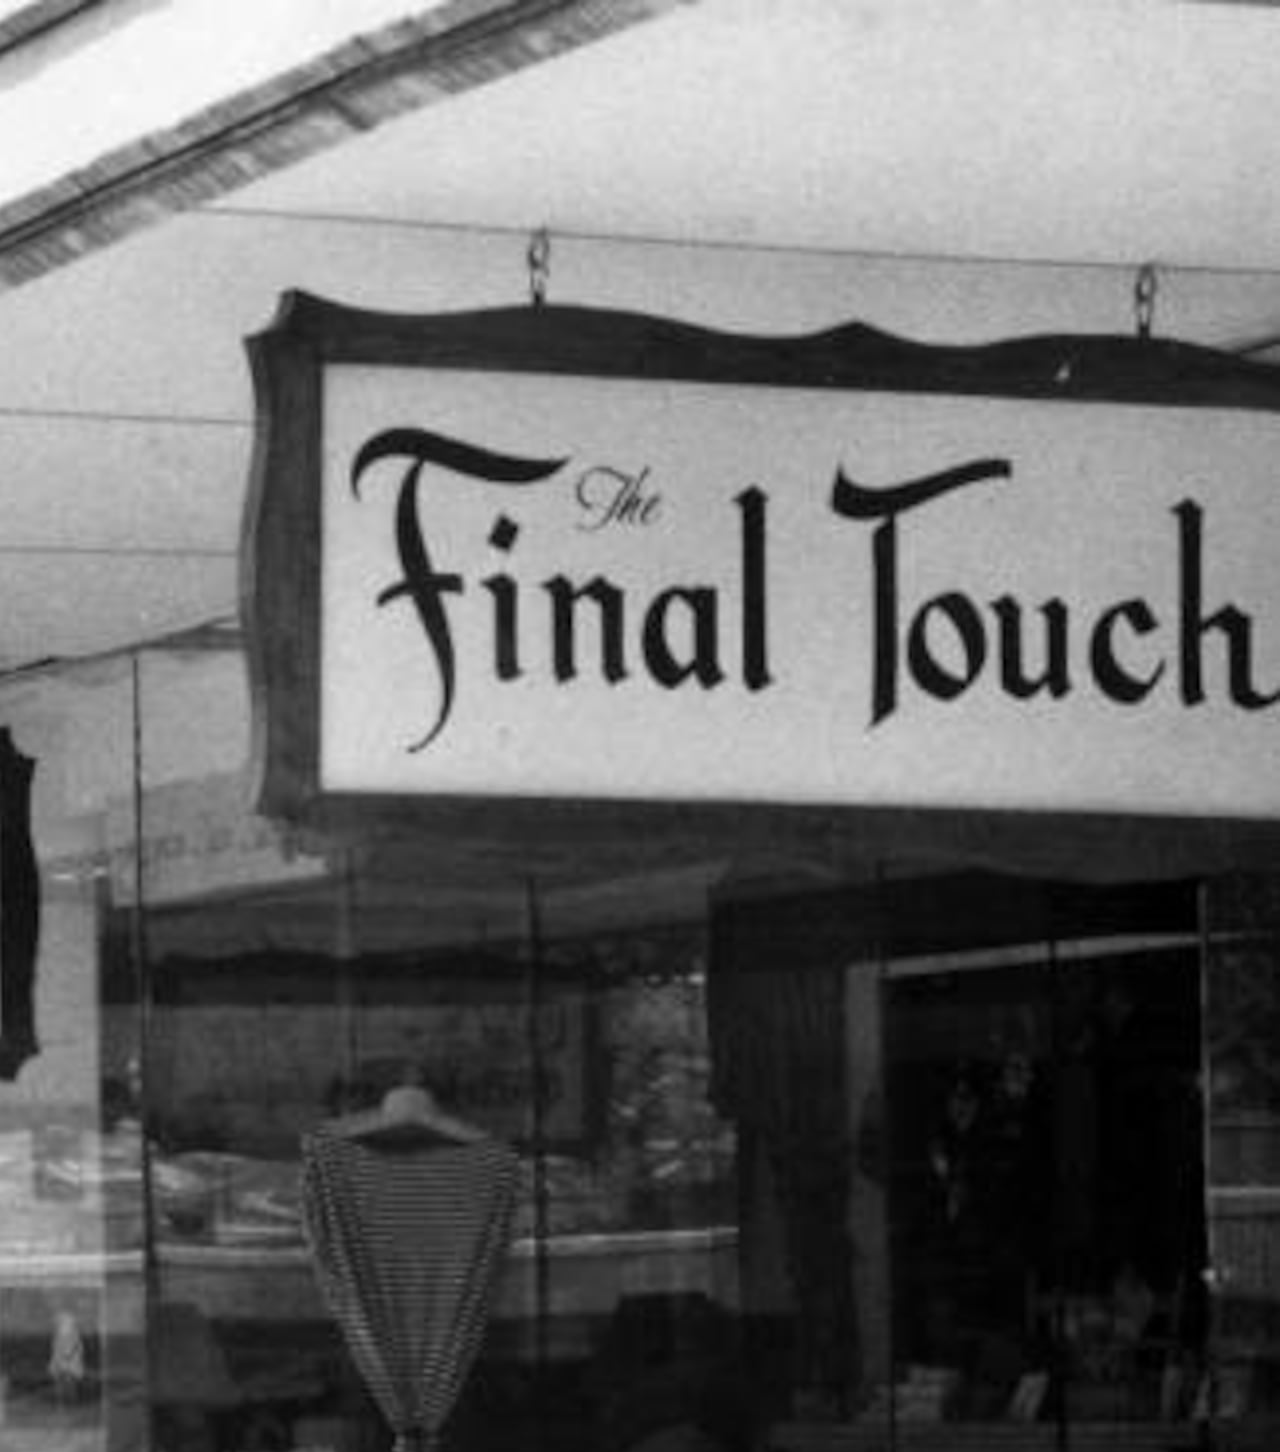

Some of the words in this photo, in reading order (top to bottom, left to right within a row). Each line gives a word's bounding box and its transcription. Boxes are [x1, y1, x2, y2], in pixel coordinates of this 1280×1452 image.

[350, 427, 772, 752] Final
[830, 458, 1280, 727] Touch
[574, 466, 664, 531] The
